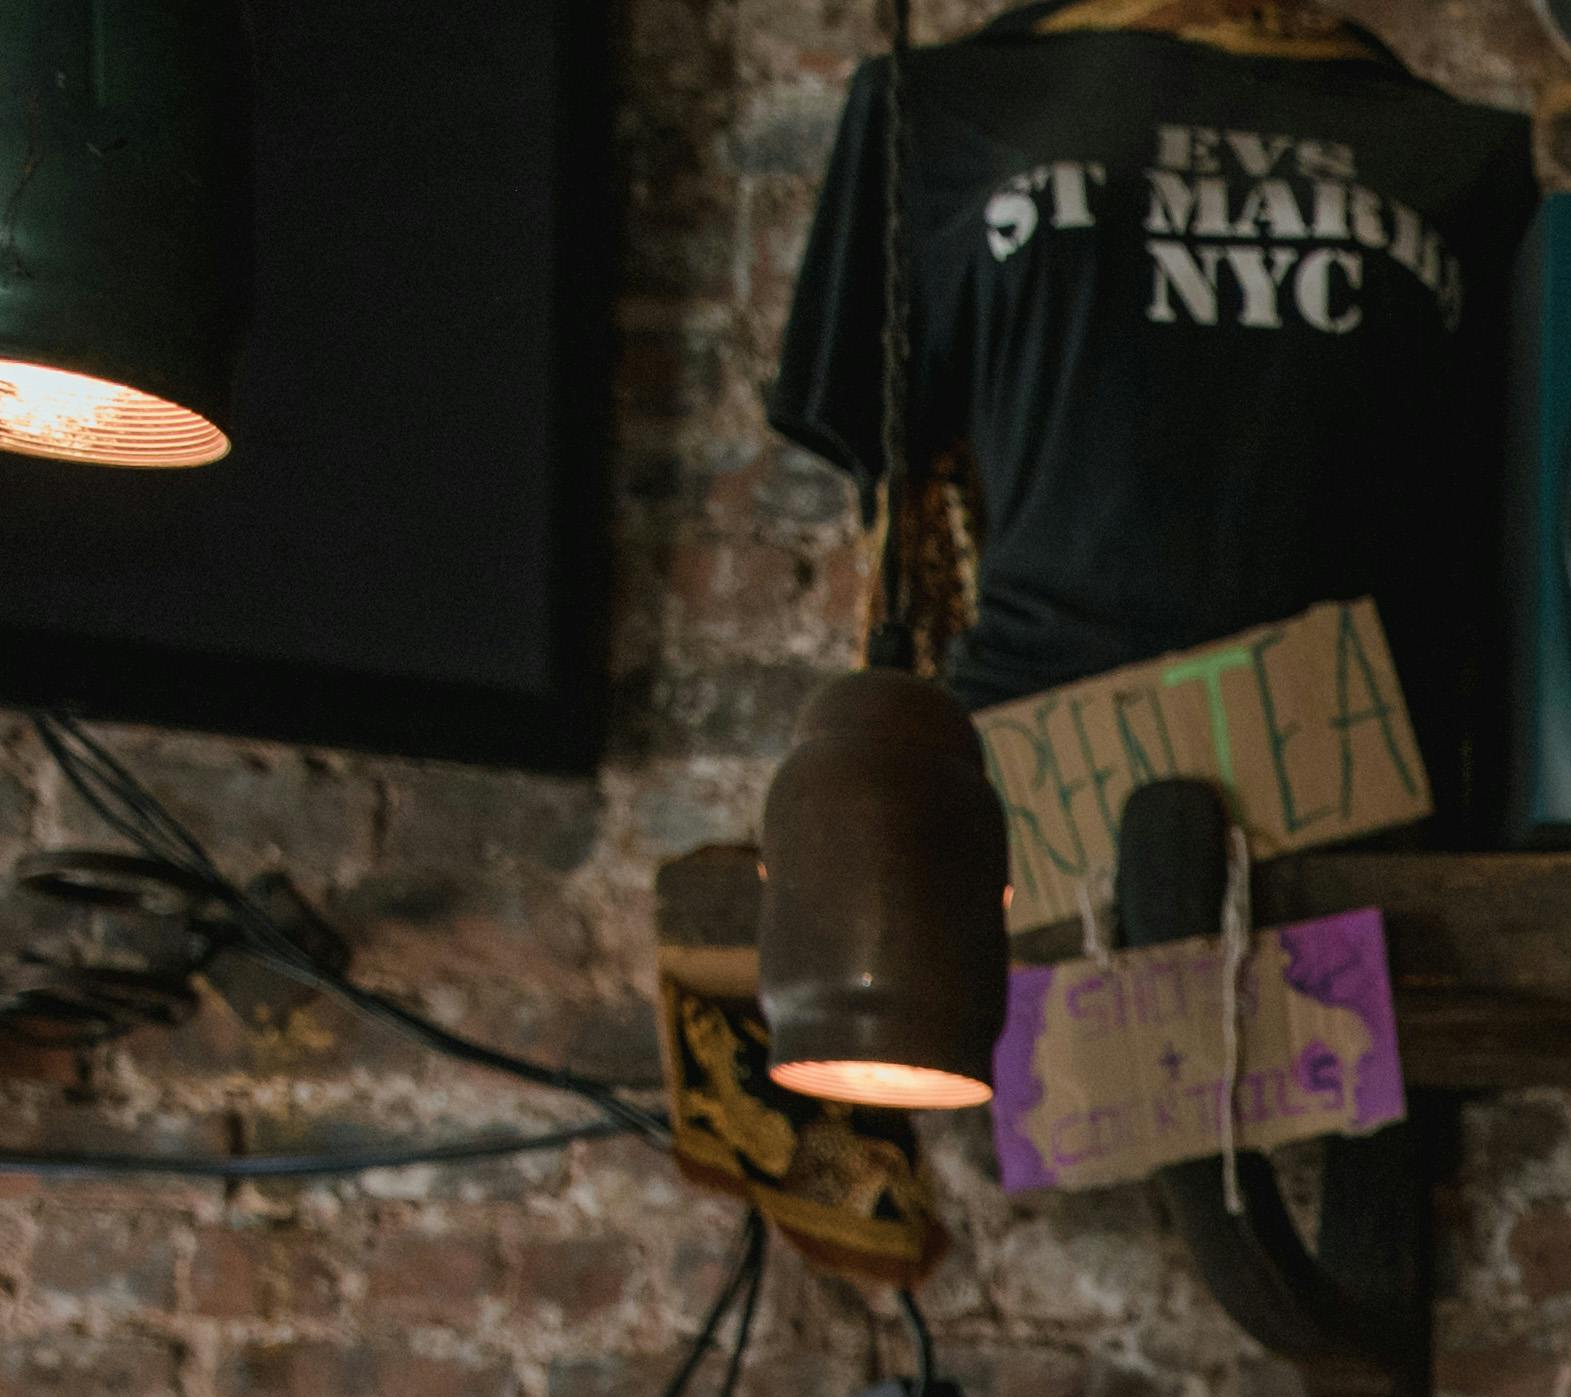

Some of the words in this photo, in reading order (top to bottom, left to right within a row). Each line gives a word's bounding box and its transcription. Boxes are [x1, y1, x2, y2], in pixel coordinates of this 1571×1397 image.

[1145, 239, 1364, 335] NYC
[977, 688, 1178, 899] REEN
[1163, 607, 1417, 835] TEA
